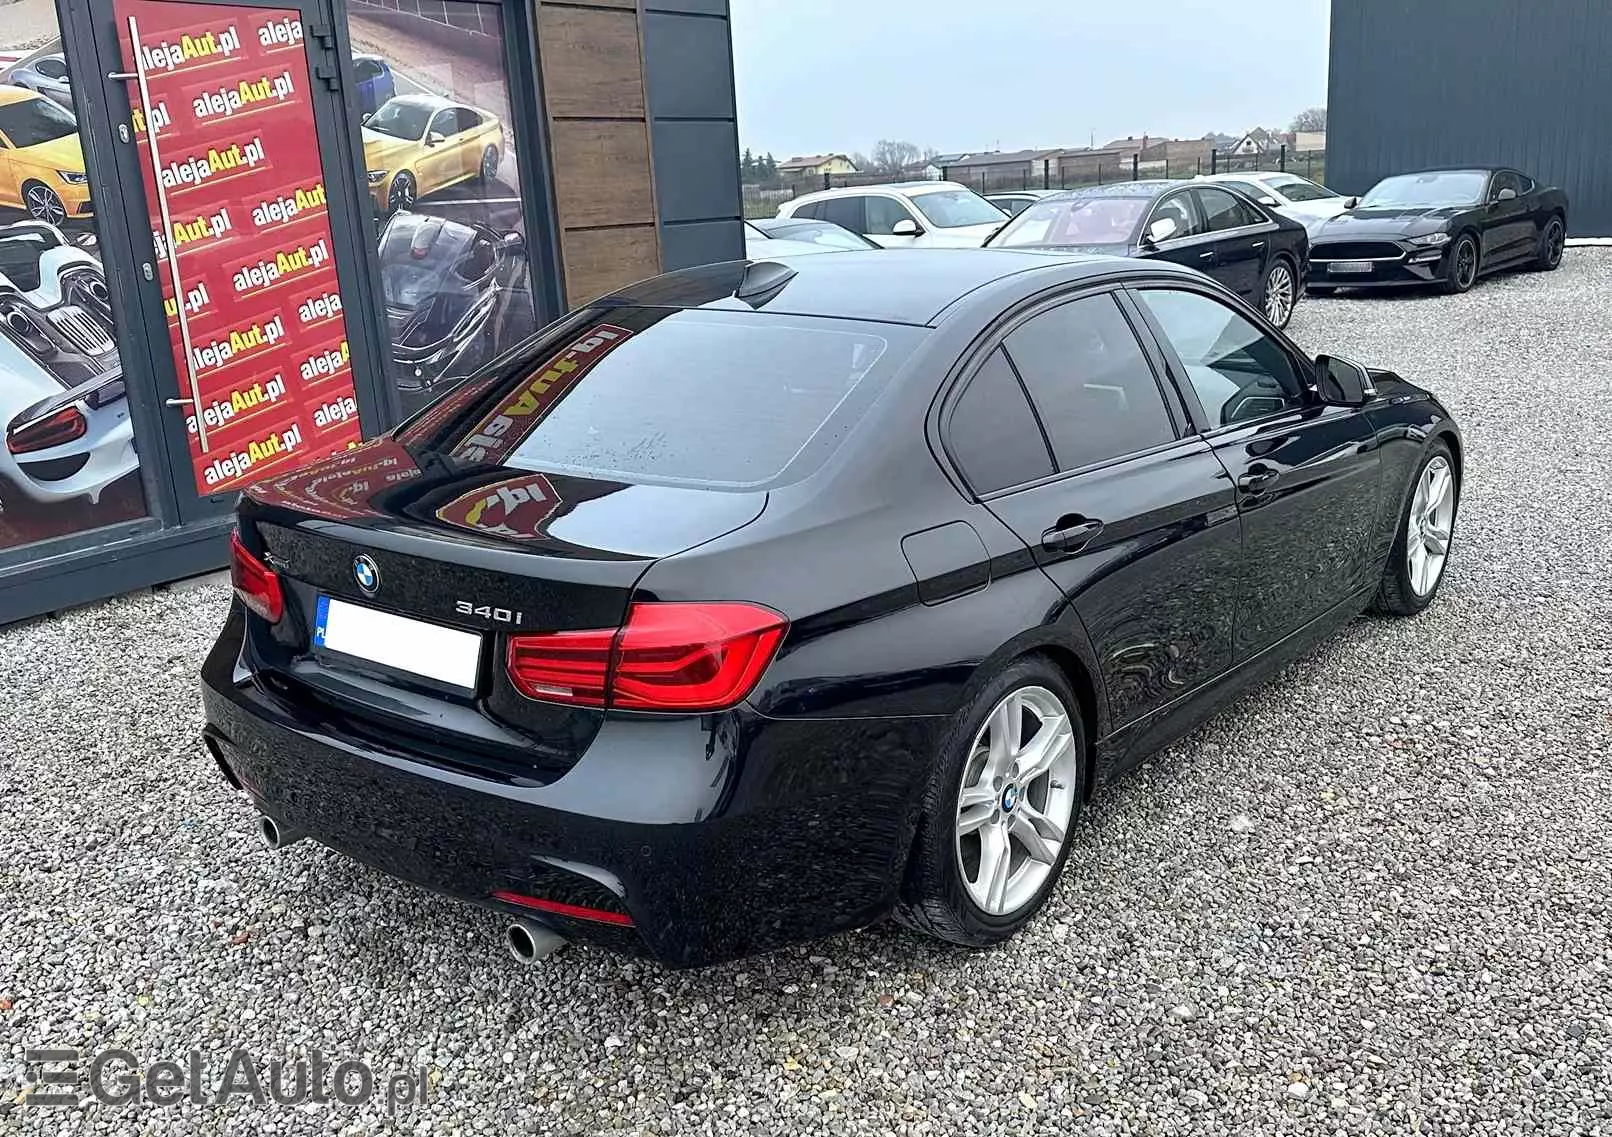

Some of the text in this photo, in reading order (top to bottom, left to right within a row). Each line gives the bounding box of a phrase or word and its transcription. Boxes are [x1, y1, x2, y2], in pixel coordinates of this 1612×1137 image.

[141, 26, 240, 71] lejaAut.pl
[258, 18, 303, 46] aleja
[192, 72, 294, 117] alejaAut.pl
[162, 138, 264, 187] alejaAut.pl
[252, 184, 326, 226] alejaAut
[233, 239, 329, 291] alejaAut.pl
[298, 293, 342, 322] aleja
[193, 315, 285, 371] lejaAut.pl
[186, 374, 286, 433] aejaAut.pl
[313, 396, 357, 427] aleja
[203, 424, 302, 485] alejaAut.pl
[456, 600, 522, 625] 340i
